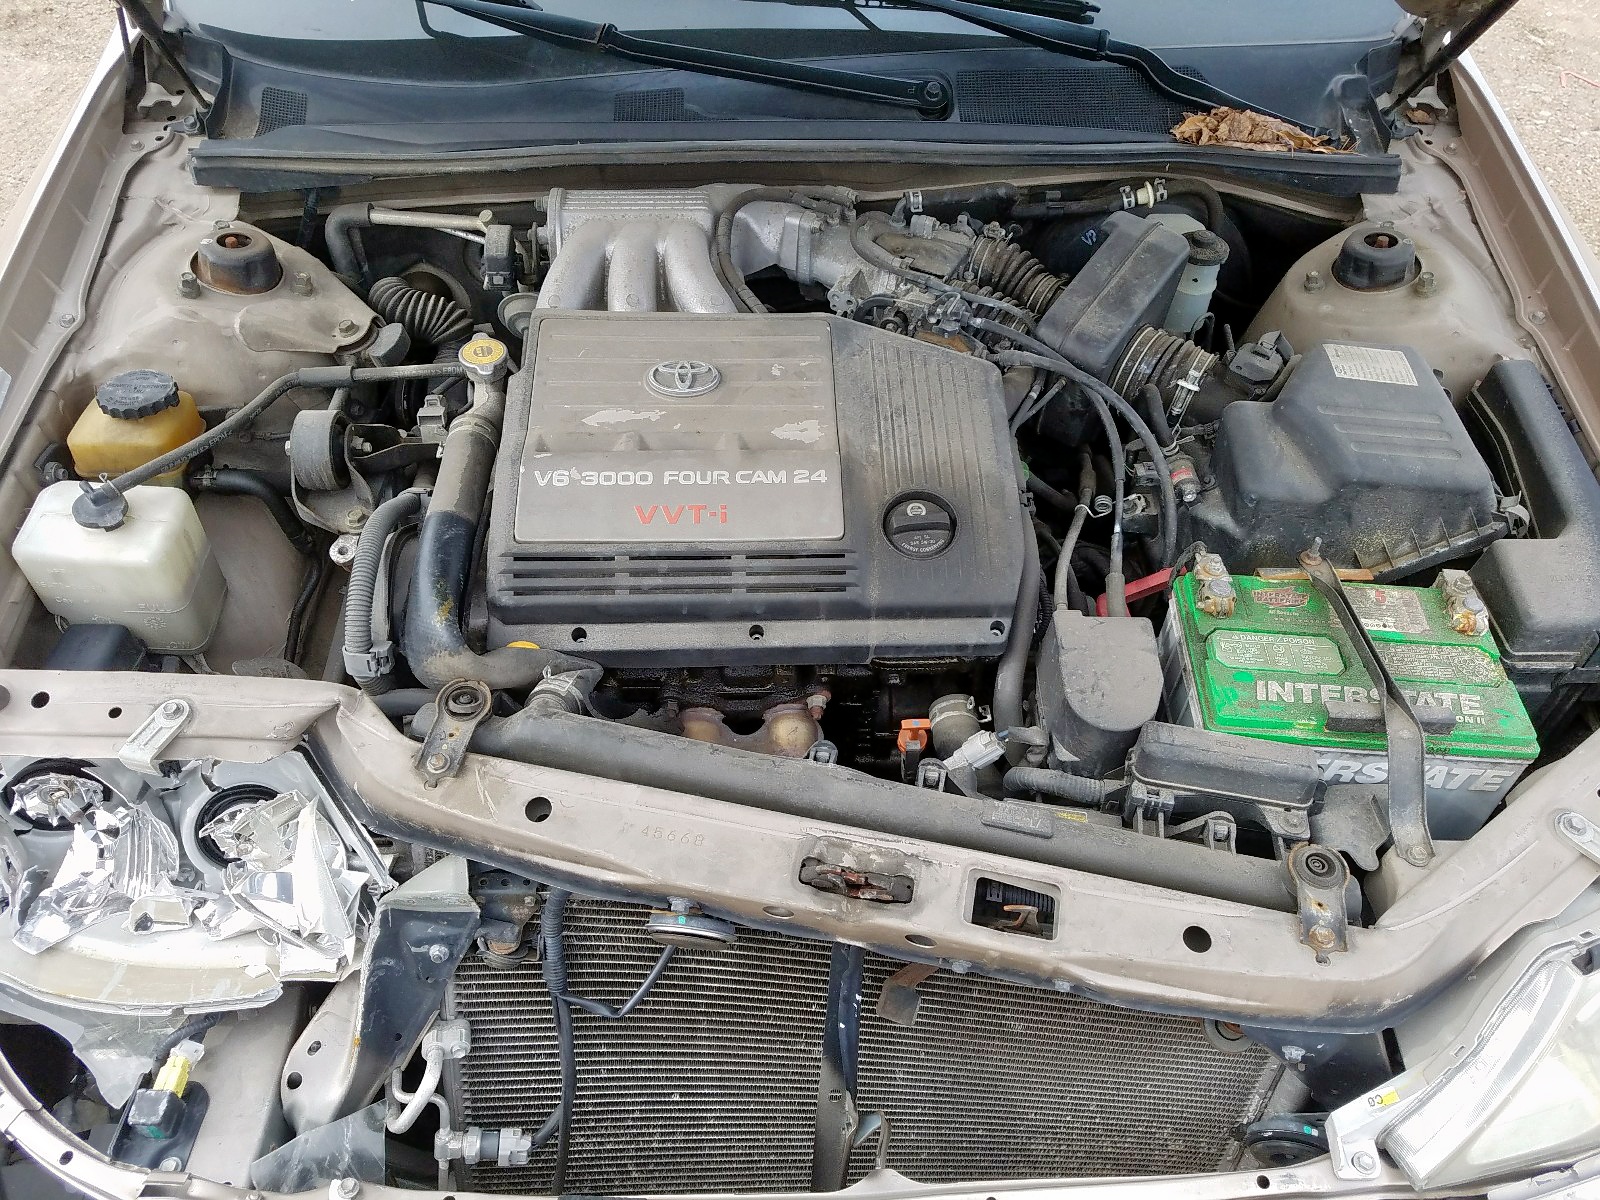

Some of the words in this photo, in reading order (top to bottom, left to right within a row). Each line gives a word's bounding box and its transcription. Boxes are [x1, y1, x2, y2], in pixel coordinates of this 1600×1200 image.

[534, 470, 570, 486] V6
[580, 470, 653, 486] 3000
[663, 470, 731, 485] FOUR
[735, 470, 786, 484] CAM
[793, 469, 828, 484] 24
[634, 504, 728, 525] VVT-i
[1375, 590, 1386, 604] 5
[1240, 634, 1274, 643] DANGER
[1284, 637, 1315, 645] POISON
[641, 824, 704, 847] 45668
